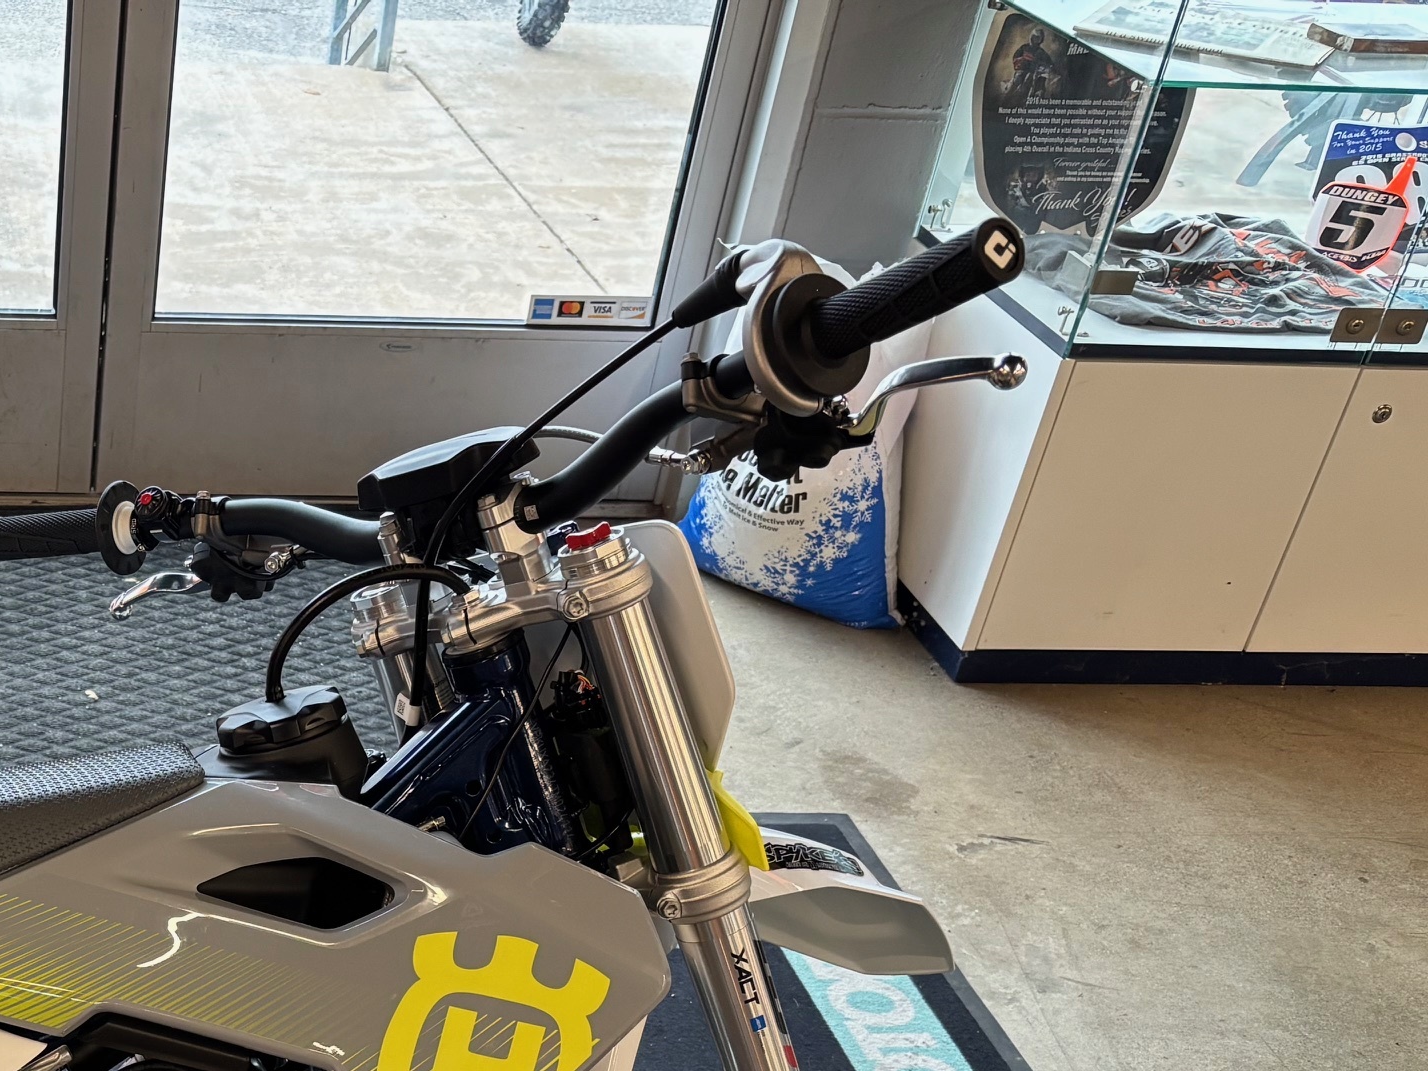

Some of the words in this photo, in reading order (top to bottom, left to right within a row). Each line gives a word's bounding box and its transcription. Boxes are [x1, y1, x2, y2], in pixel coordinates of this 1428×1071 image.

[1334, 130, 1366, 140] Thank
[1370, 128, 1390, 137] You
[1359, 144, 1382, 152] 2015
[1032, 190, 1082, 214] Thank
[1329, 186, 1400, 205] DUNGEY
[1320, 201, 1387, 250] 5
[735, 472, 807, 514] Melter
[753, 512, 785, 526] Effective
[787, 518, 804, 526] Way
[758, 522, 778, 532] Snow
[730, 948, 761, 1006] XACT
